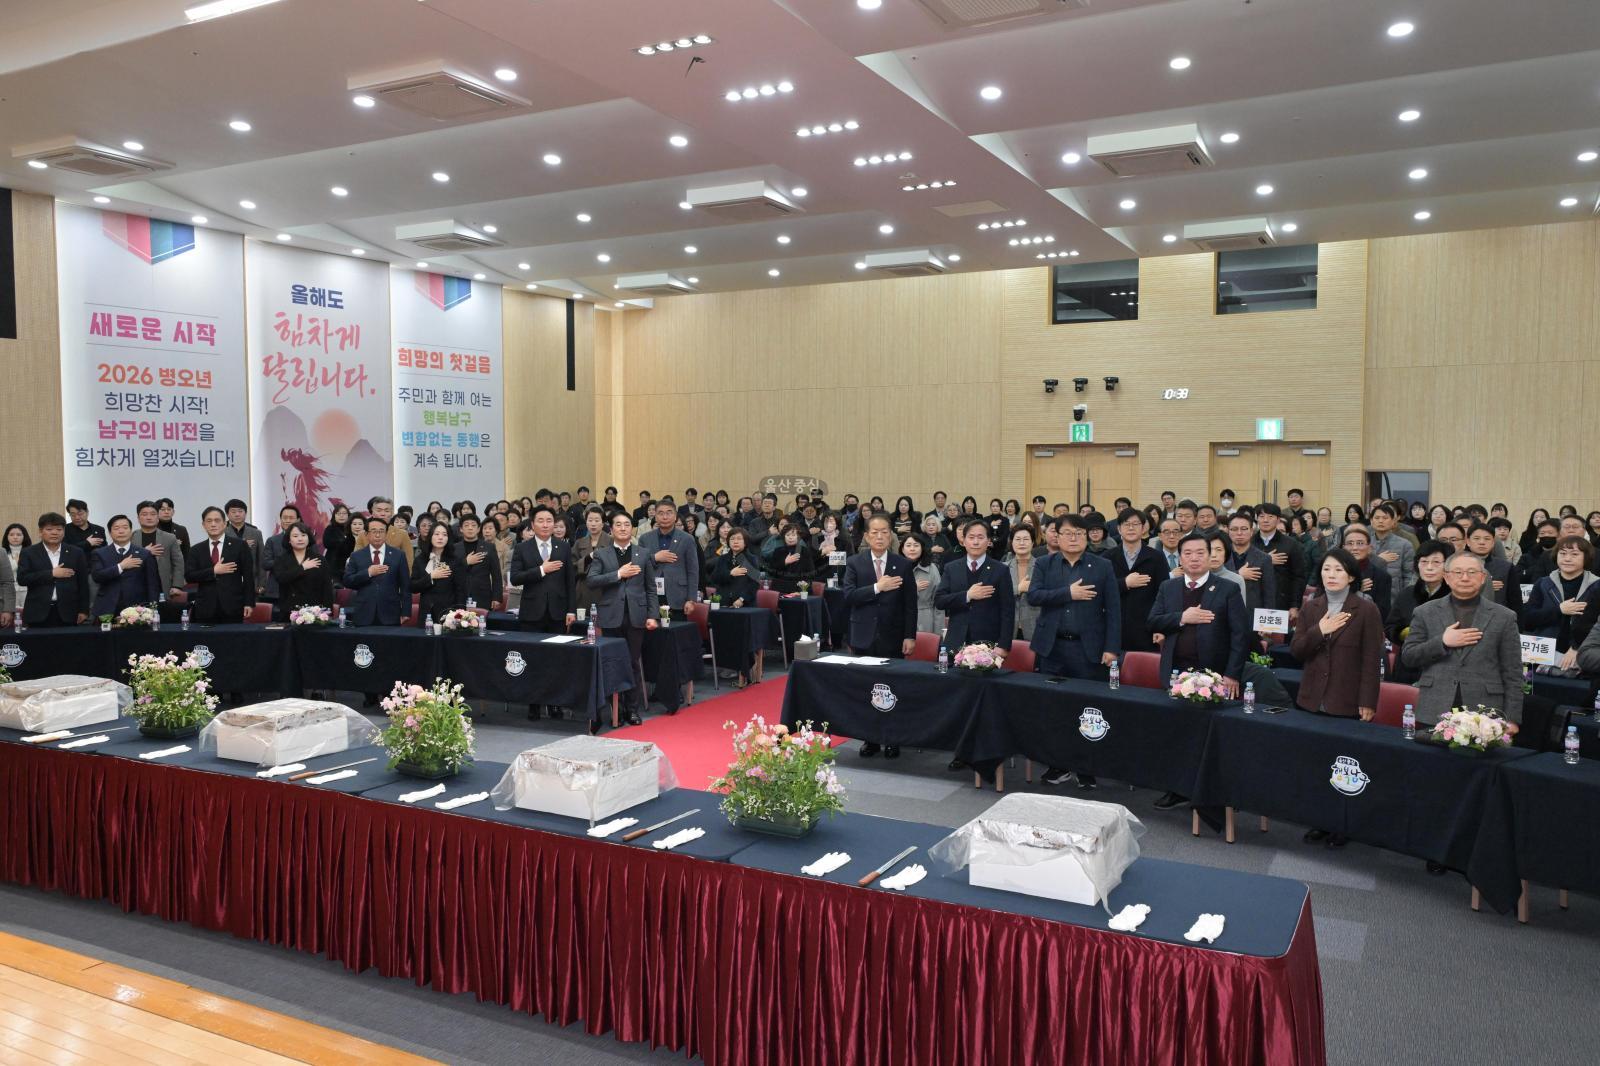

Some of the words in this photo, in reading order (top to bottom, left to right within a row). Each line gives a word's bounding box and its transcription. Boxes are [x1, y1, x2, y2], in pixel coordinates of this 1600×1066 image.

[291, 284, 344, 309] 올해도
[90, 312, 162, 341] 새로운
[173, 321, 217, 346] 시작
[274, 311, 360, 354] 힘차게
[398, 348, 444, 370] 희망의
[449, 353, 490, 374] 첫걸음
[97, 363, 154, 385] 2026
[158, 368, 212, 389] 병오년
[262, 352, 376, 404] 달립니다.
[105, 392, 162, 413] 희망찬
[169, 395, 209, 415] 시작!
[398, 387, 437, 404] 주민과
[442, 390, 465, 406] 함께
[470, 392, 491, 407] 여는
[423, 410, 471, 427] 행복남구
[98, 420, 156, 440] 남구의
[163, 422, 215, 442] 비전을
[402, 432, 451, 447] 변함없는
[457, 432, 490, 448] 동행은
[75, 447, 135, 468] 힘차게
[142, 448, 235, 468] 열겠습니다!
[414, 453, 438, 468] 계속
[444, 454, 482, 468] 됩니다.
